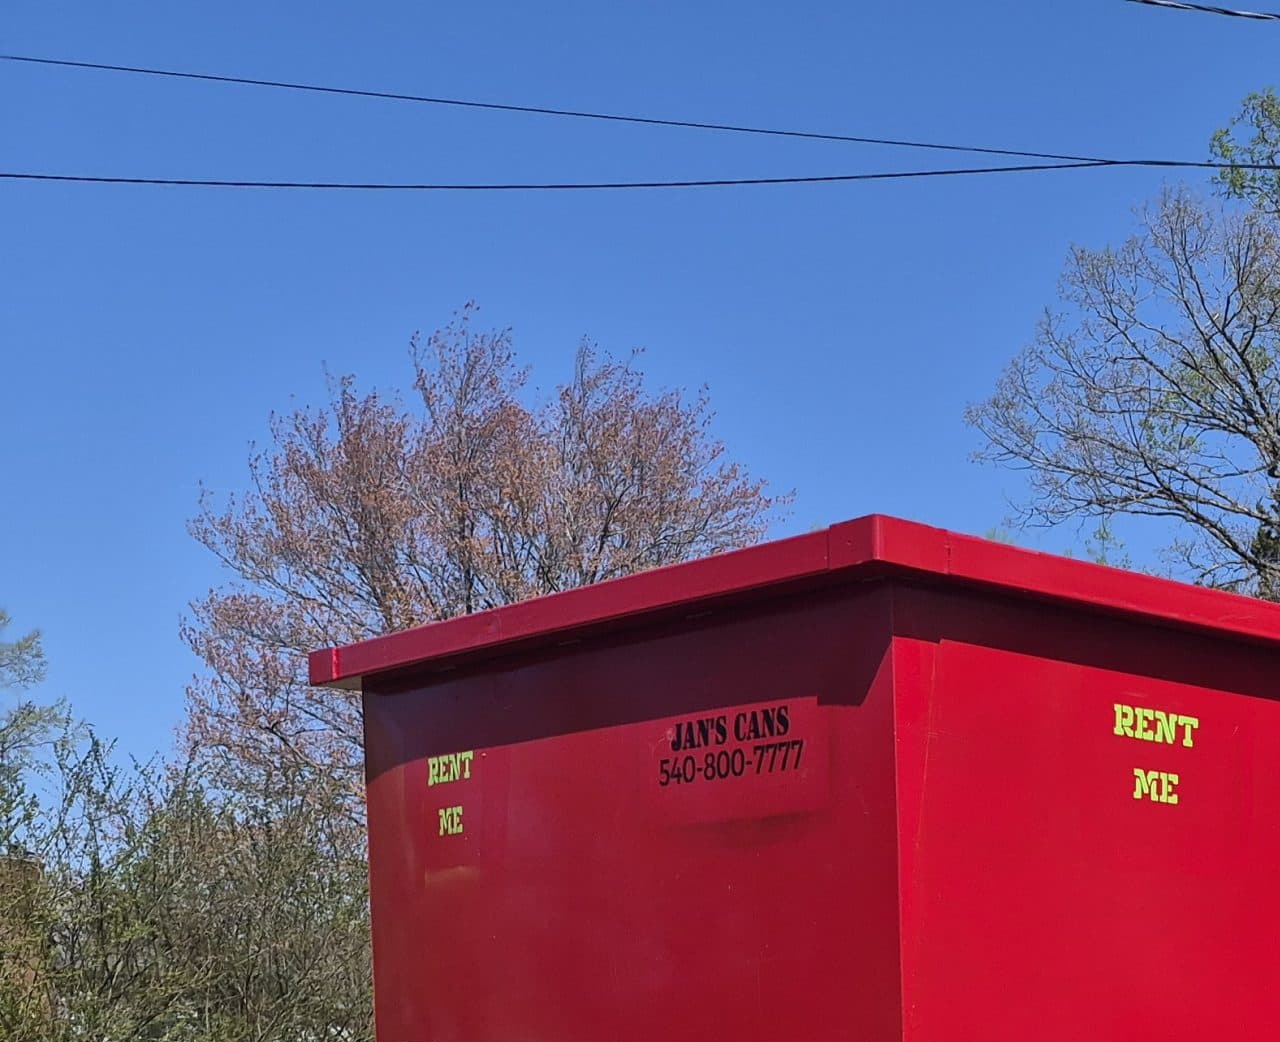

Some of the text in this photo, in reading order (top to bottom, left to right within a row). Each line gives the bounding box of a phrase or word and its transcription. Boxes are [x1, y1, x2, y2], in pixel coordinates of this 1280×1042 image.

[671, 705, 789, 751] JAN'S CANS
[1113, 703, 1199, 748] RENT
[427, 750, 473, 786] RENT
[658, 739, 804, 787] 540-800-7777
[1133, 767, 1179, 804] ME
[438, 806, 464, 836] ME
